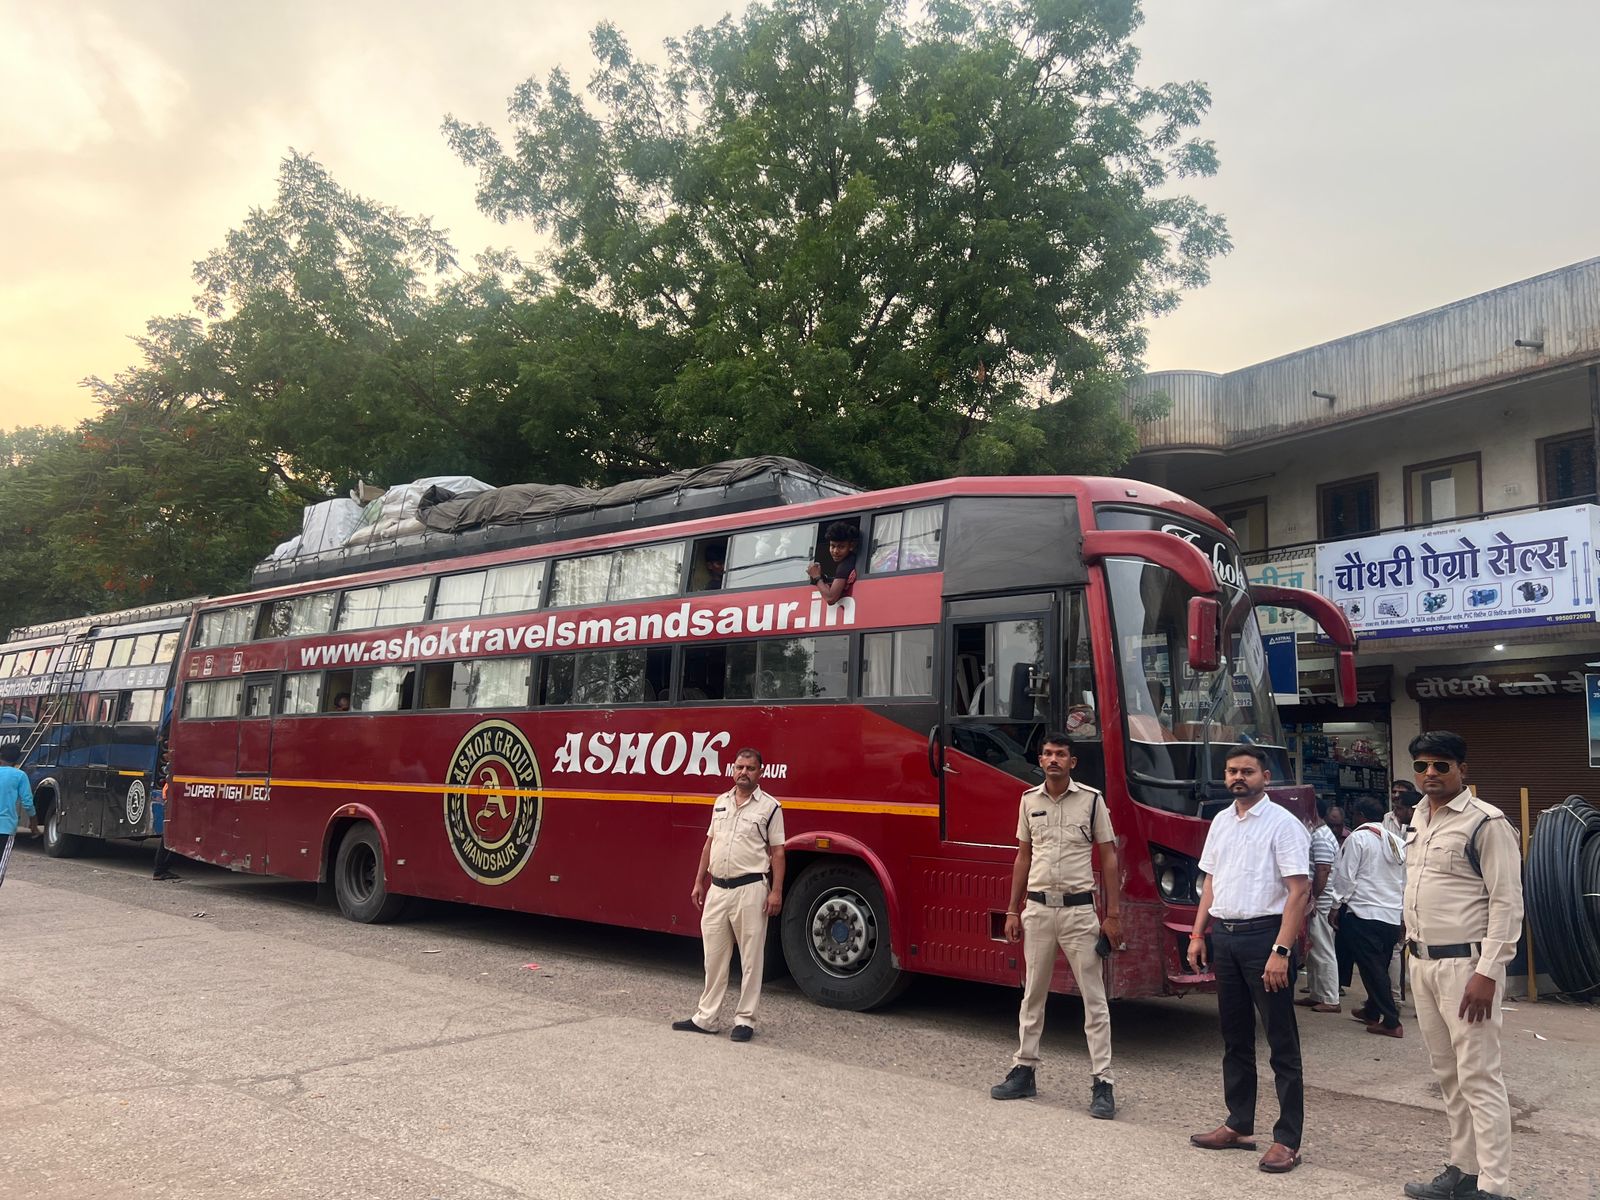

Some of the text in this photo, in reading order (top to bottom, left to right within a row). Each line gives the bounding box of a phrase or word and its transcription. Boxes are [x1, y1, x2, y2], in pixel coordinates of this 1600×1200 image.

[1334, 544, 1415, 592] चौधरी
[1420, 536, 1480, 589] ऐग्रो
[1487, 531, 1569, 576] सेल्स
[300, 591, 856, 668] www.ashoktravelsmandsaur.in
[1416, 673, 1493, 698] चौधरी
[453, 730, 533, 784] ASHOK GROUP
[551, 730, 732, 778] ASHOK
[184, 783, 215, 798] SUPER
[216, 784, 243, 800] HIGH
[461, 837, 519, 872] MANDSAUR
